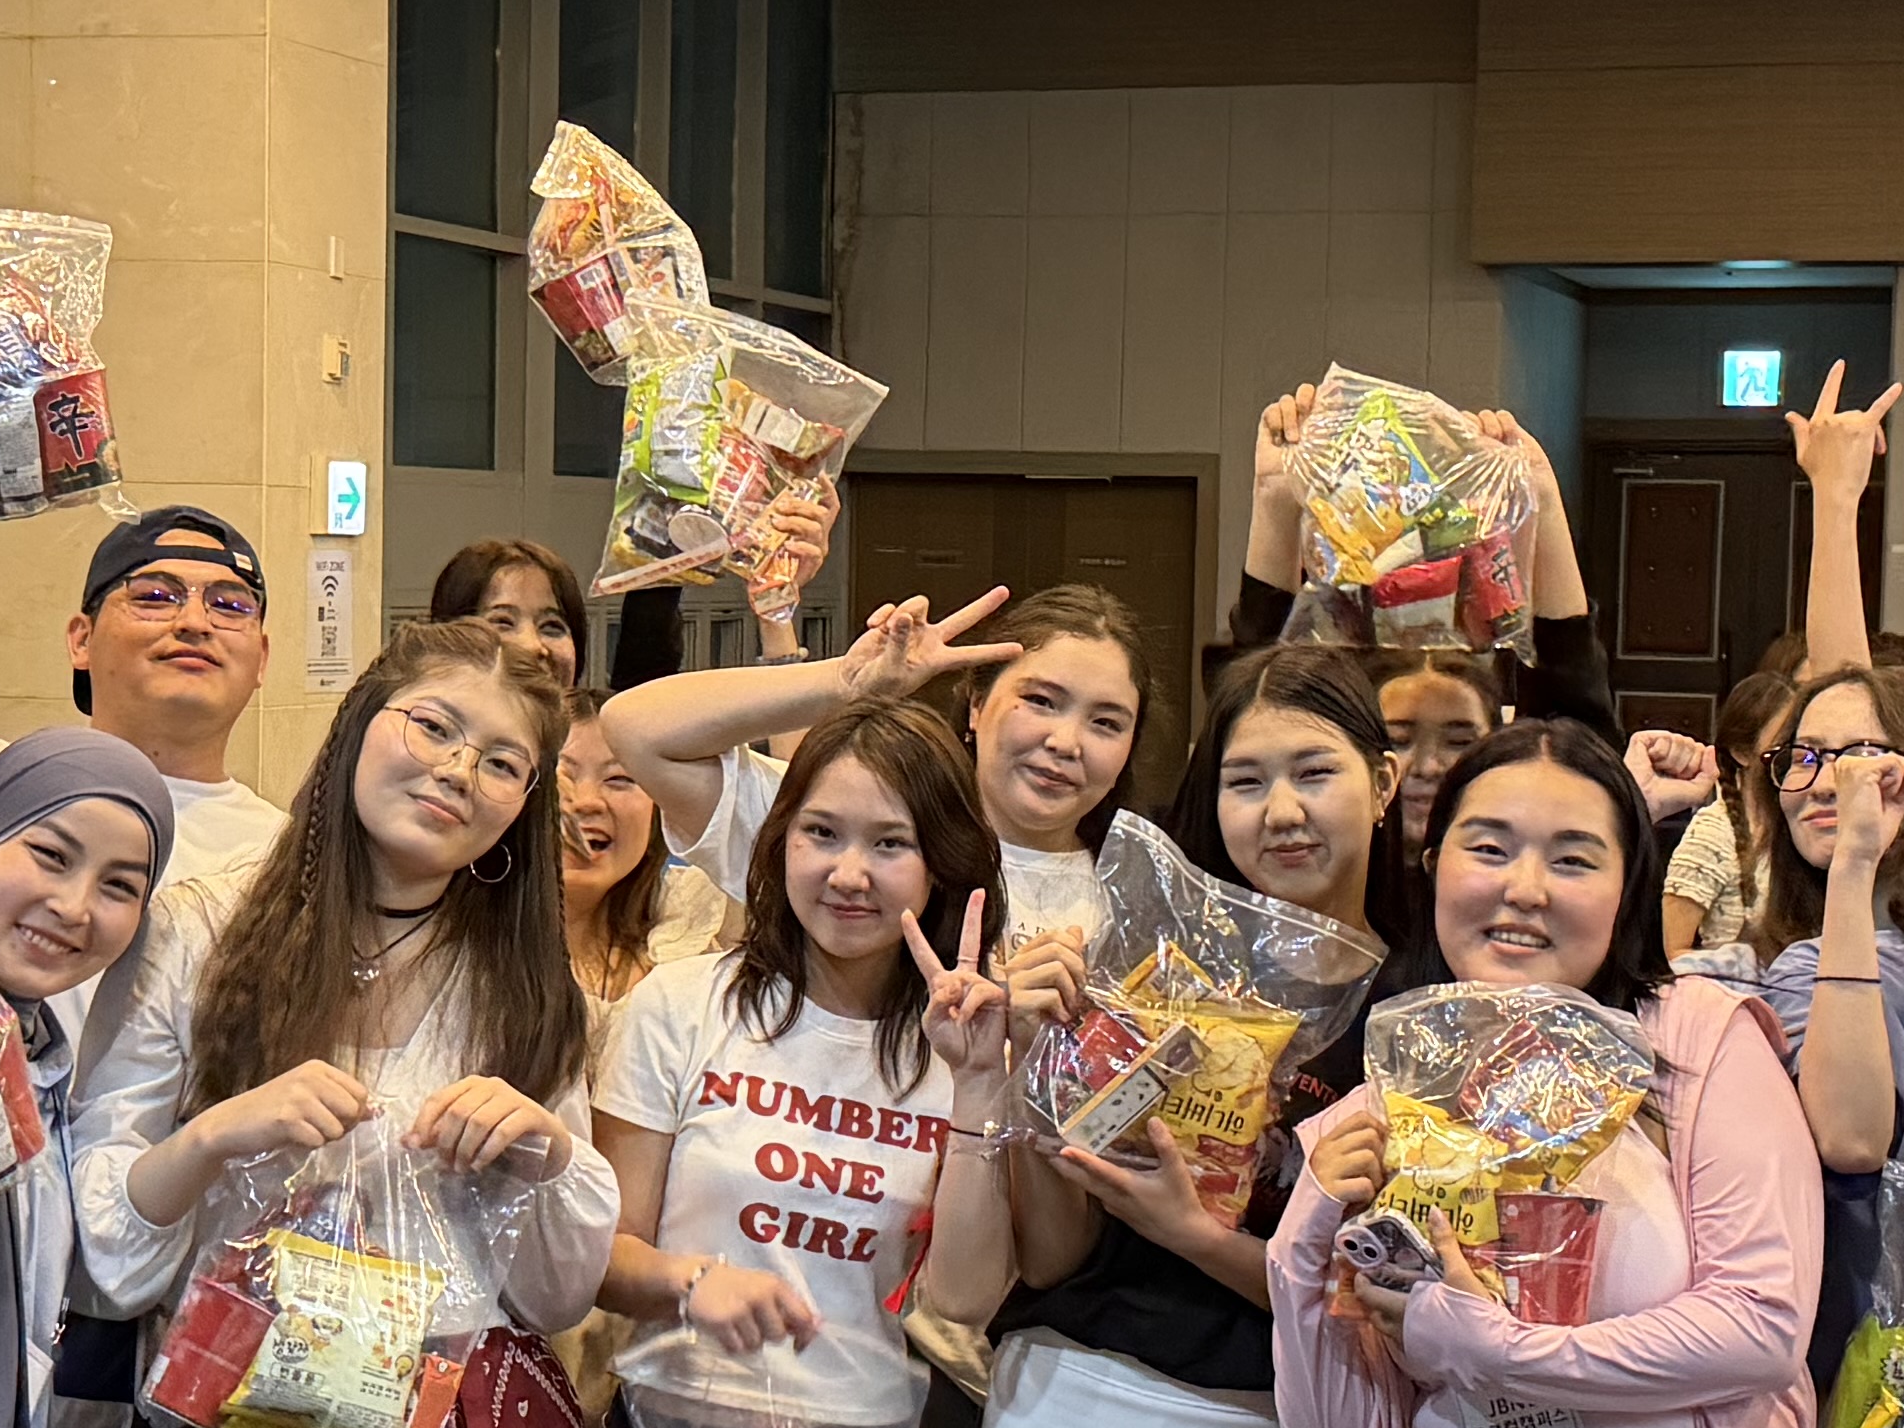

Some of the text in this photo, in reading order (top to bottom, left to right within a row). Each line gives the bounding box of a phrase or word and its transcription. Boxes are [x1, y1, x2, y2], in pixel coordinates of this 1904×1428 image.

[47, 391, 95, 460] 辛
[698, 1070, 951, 1153] NUMBER
[755, 1142, 885, 1204] ONE
[738, 1202, 879, 1263] GIRL
[1489, 1397, 1536, 1418] JB
